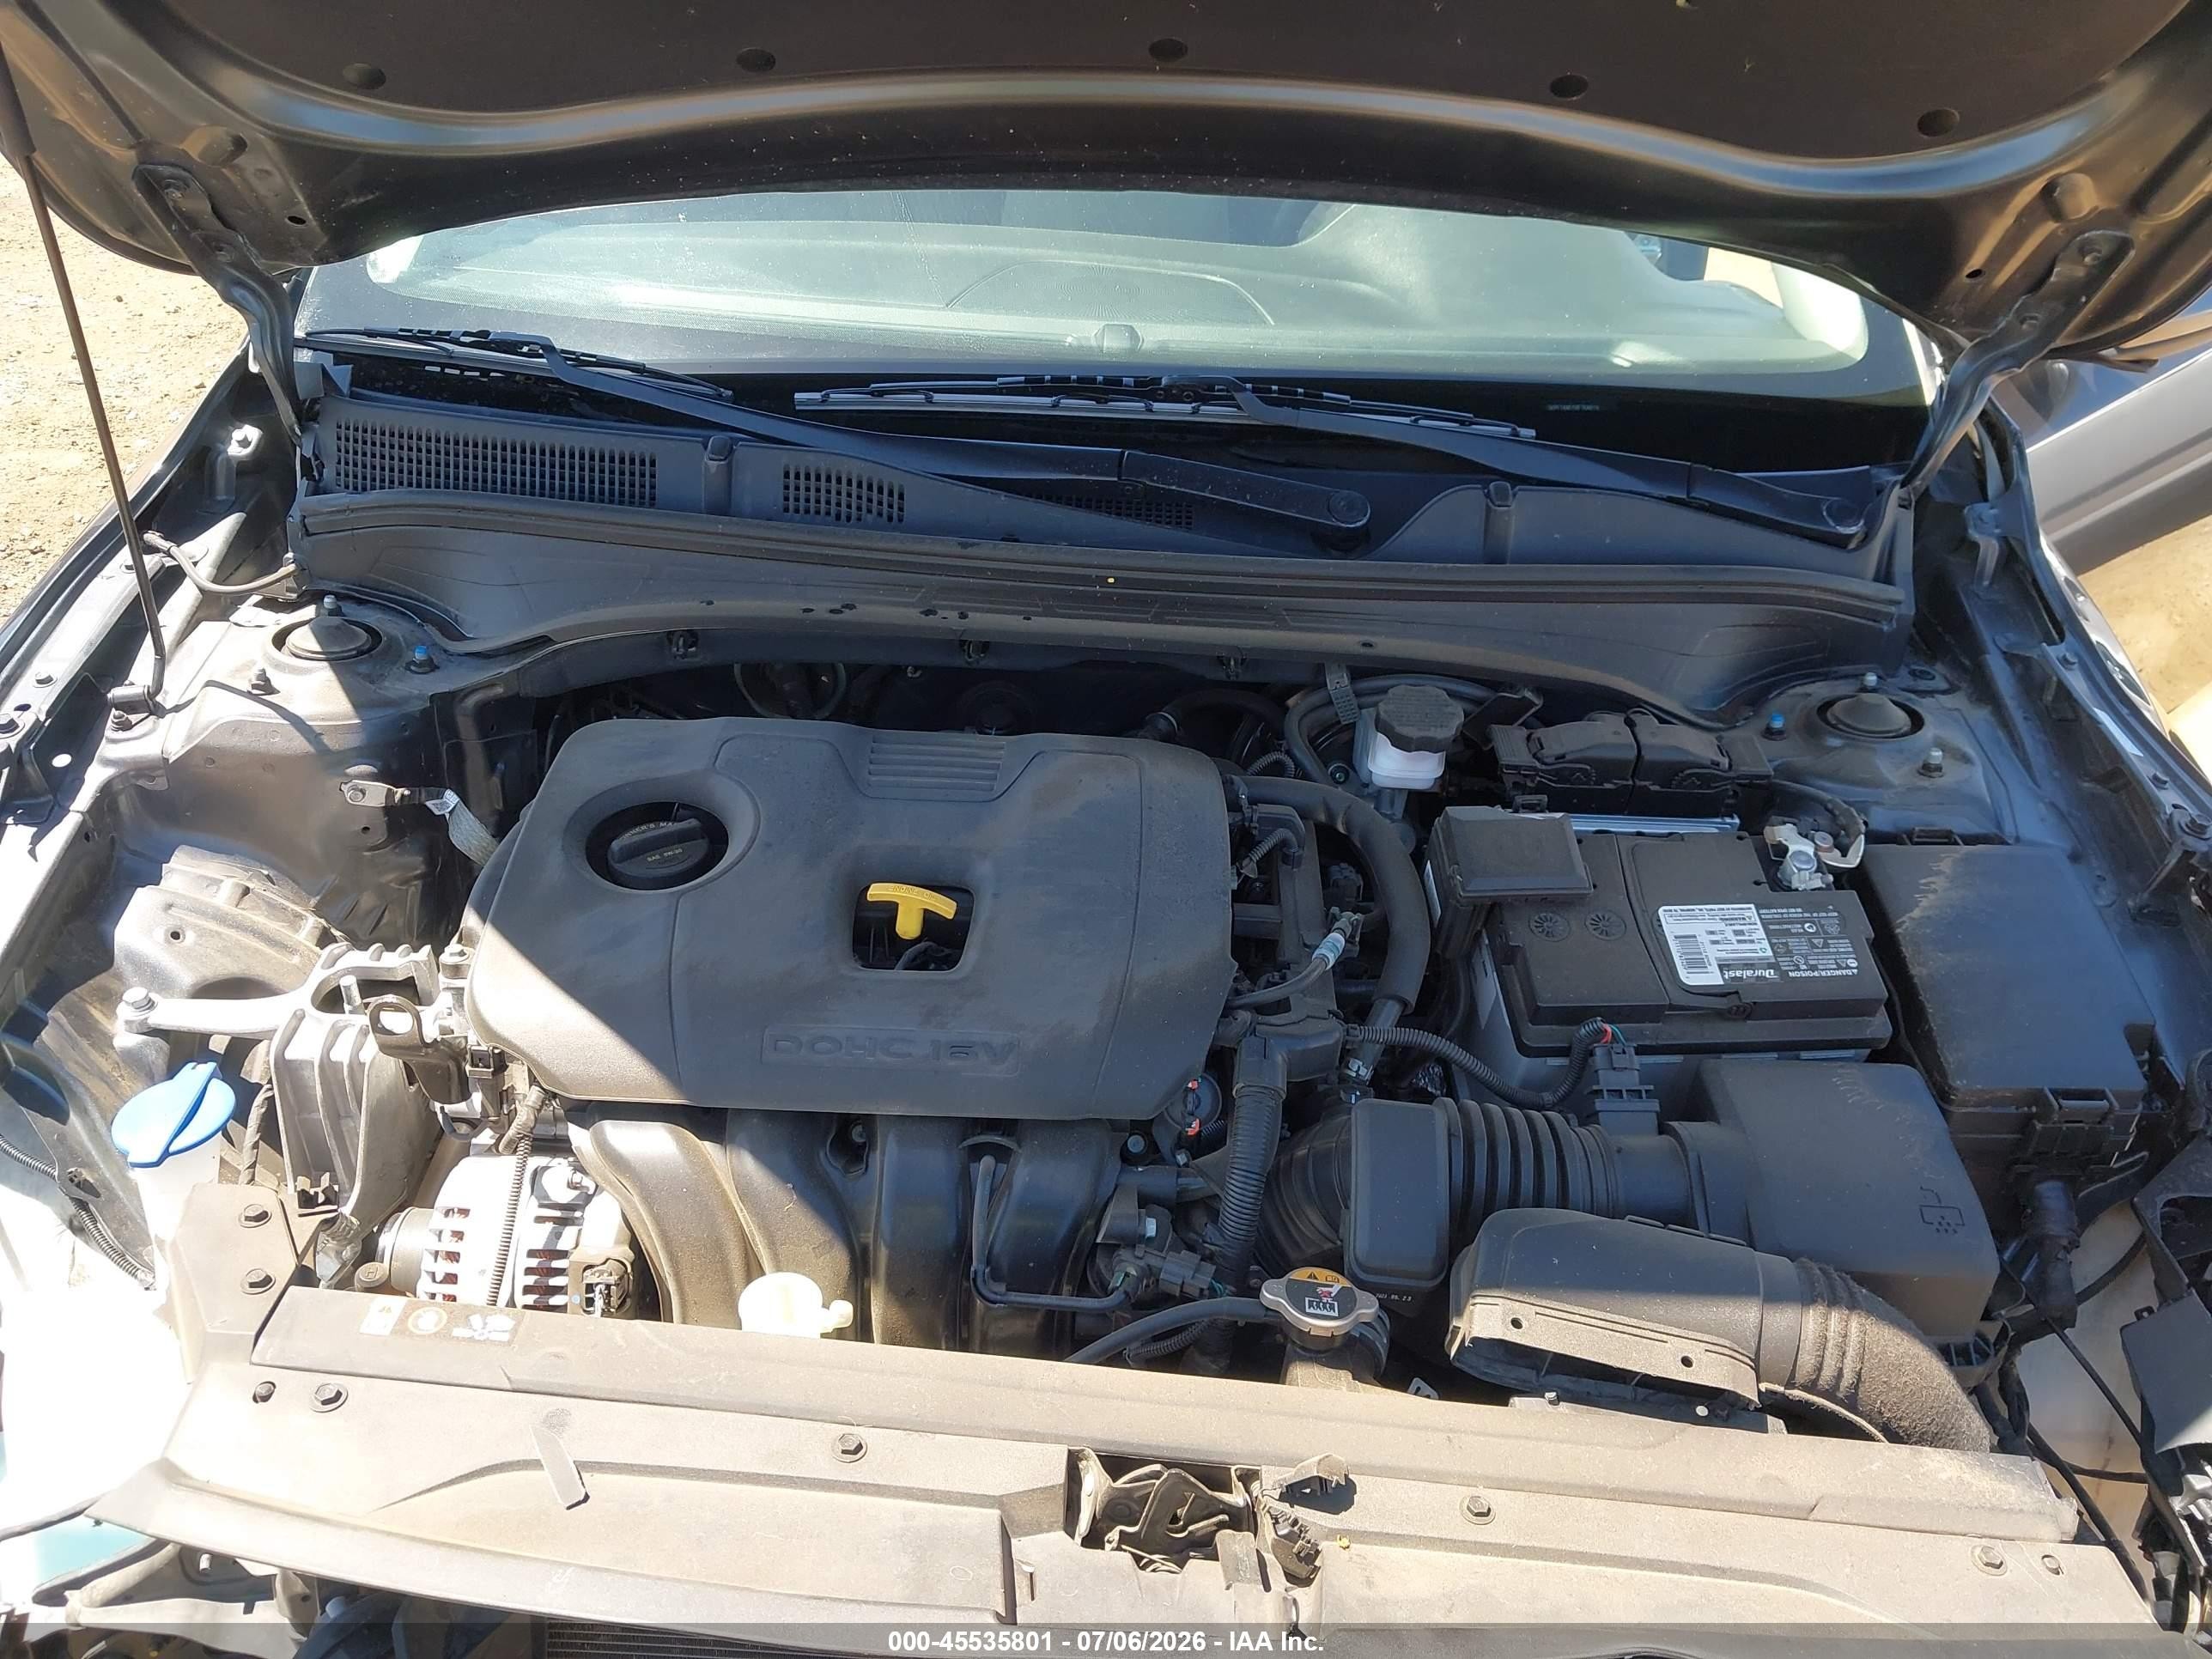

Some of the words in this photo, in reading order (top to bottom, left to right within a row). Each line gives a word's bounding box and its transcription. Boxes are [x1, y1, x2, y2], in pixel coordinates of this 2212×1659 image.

[1723, 969, 1779, 979] Duralast
[773, 1035, 915, 1059] DOHC
[929, 1039, 1018, 1065] 16V
